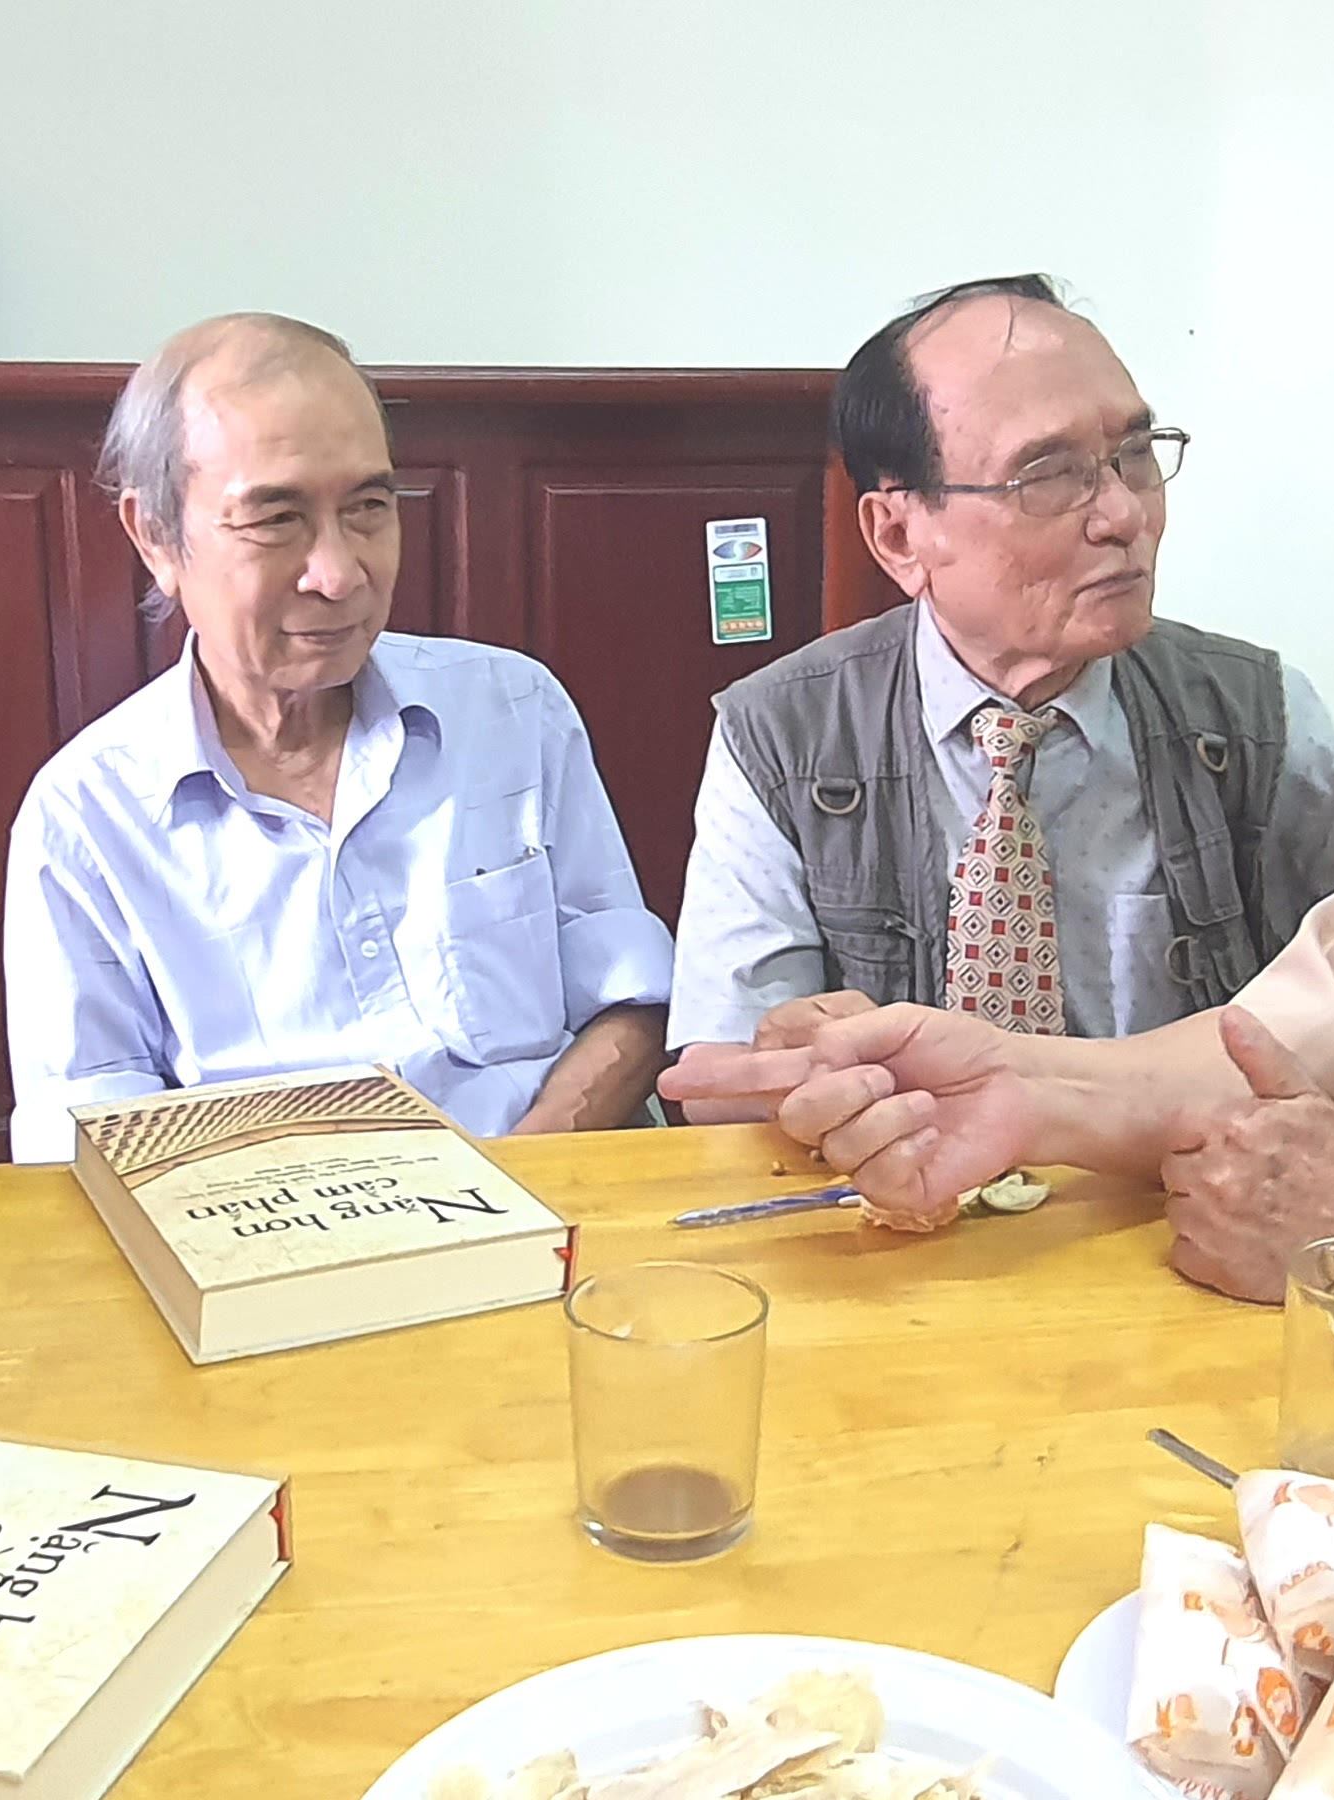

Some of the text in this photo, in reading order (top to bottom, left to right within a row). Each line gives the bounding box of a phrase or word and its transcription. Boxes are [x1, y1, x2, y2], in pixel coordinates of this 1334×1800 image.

[185, 1187, 299, 1221] phấn
[313, 1176, 399, 1198] cầm
[231, 1187, 509, 1238] Nặng hơn
